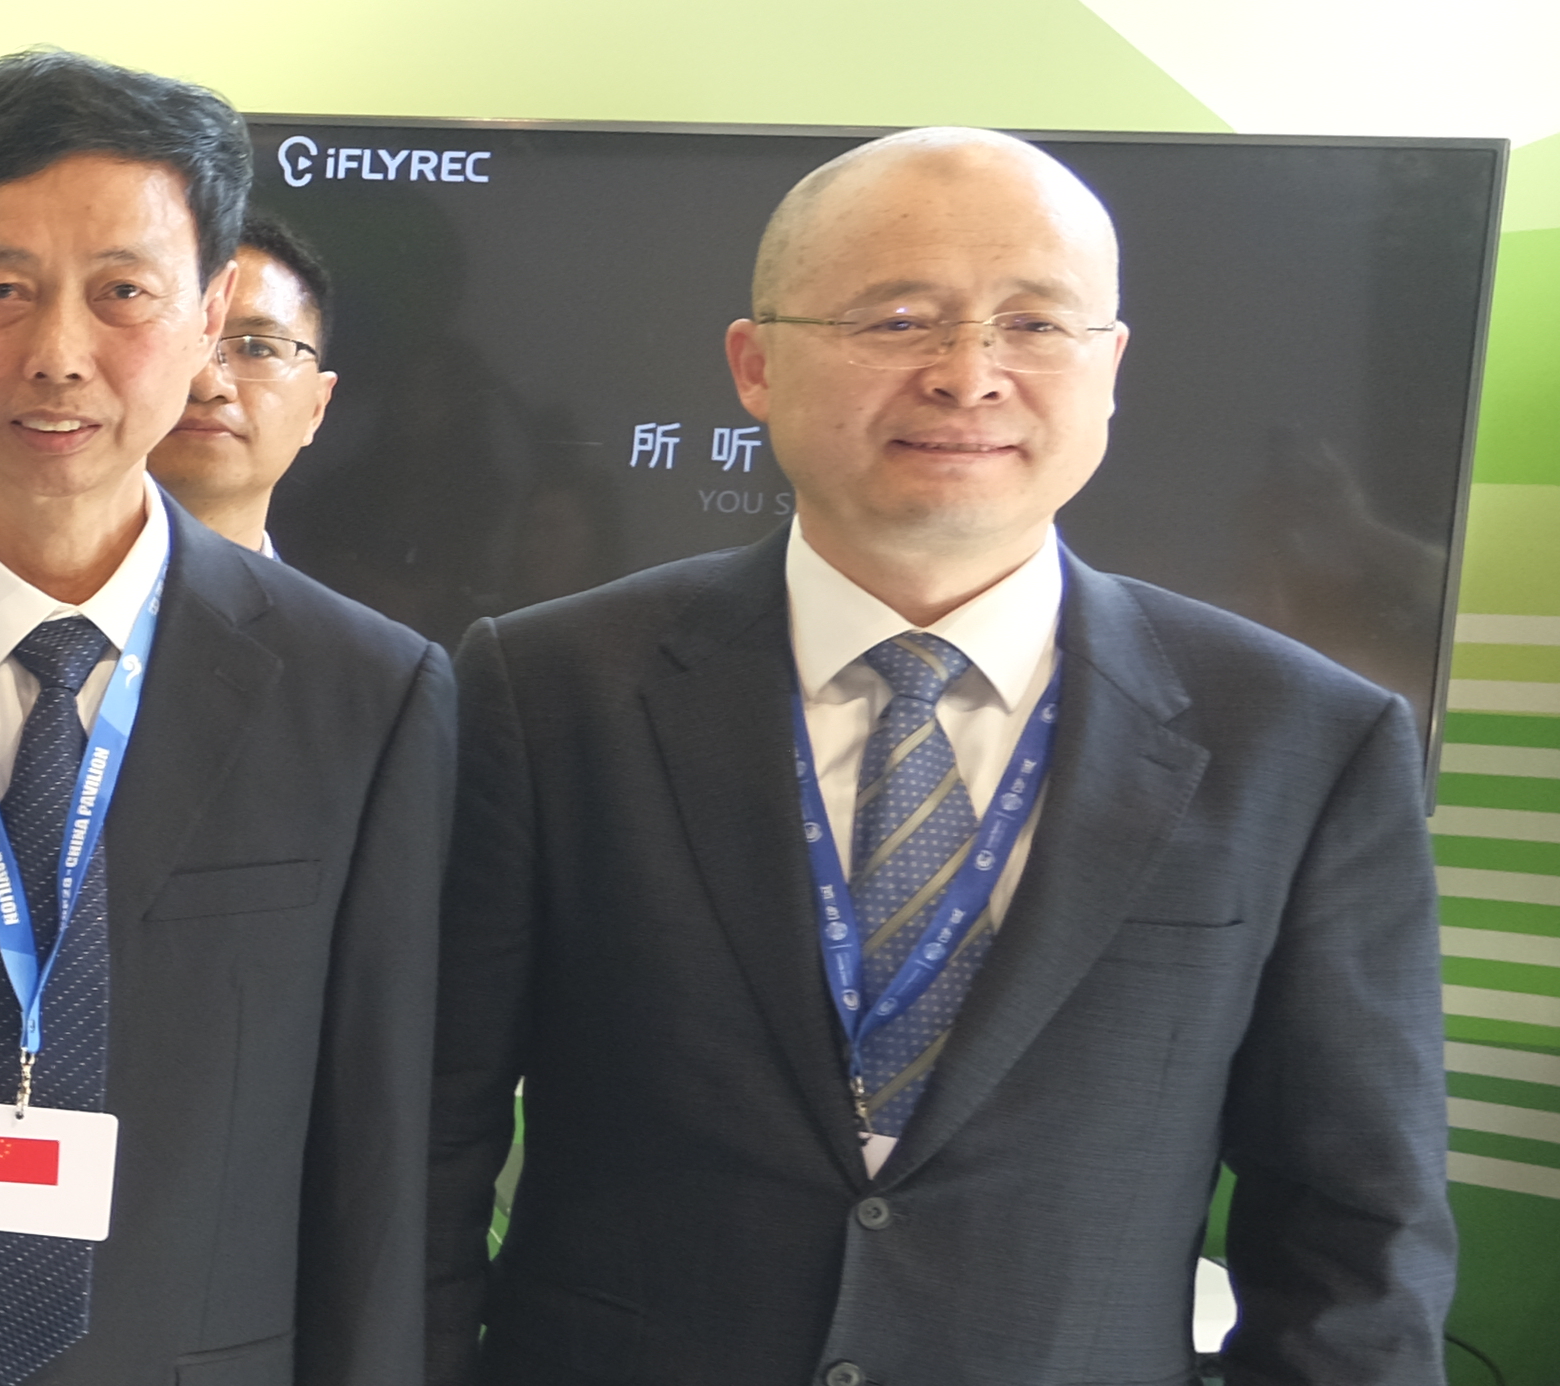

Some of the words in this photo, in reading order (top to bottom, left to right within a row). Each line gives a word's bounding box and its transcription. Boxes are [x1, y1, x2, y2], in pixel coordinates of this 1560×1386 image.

[325, 147, 492, 184] iFLYREC
[698, 489, 763, 514] YOU
[77, 747, 110, 816] PAVILION
[65, 818, 90, 868] CHINA
